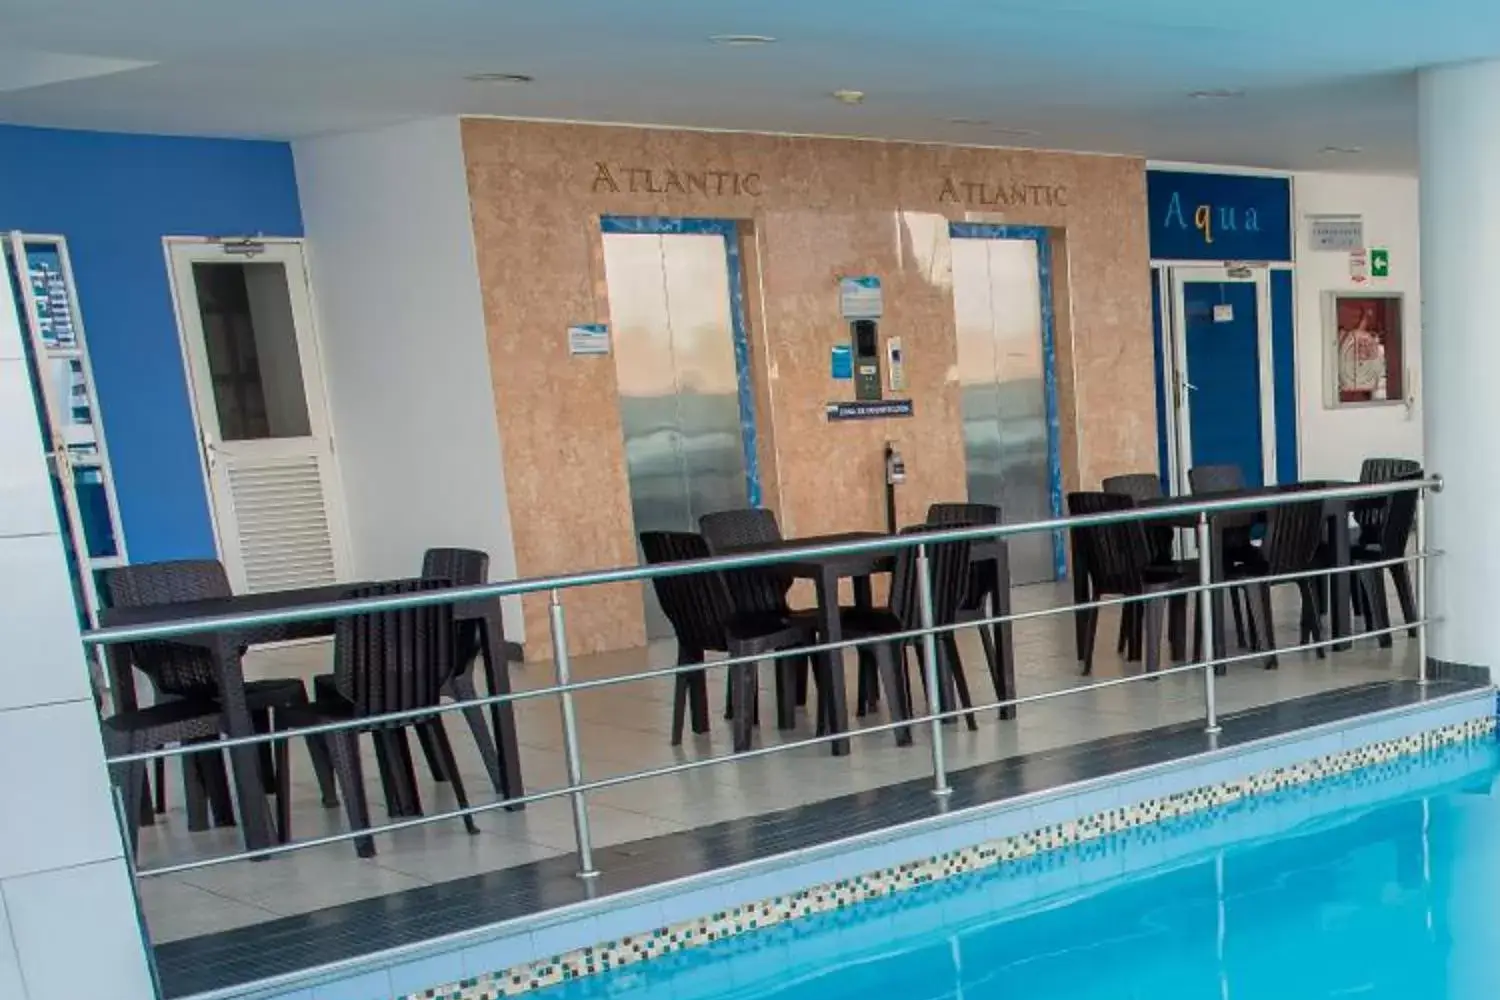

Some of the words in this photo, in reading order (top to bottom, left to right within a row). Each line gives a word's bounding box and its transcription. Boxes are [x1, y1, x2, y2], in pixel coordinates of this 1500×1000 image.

[591, 161, 762, 199] ATLANTIC
[938, 178, 1067, 207] ATLANTIC
[1163, 191, 1261, 244] Aqua
